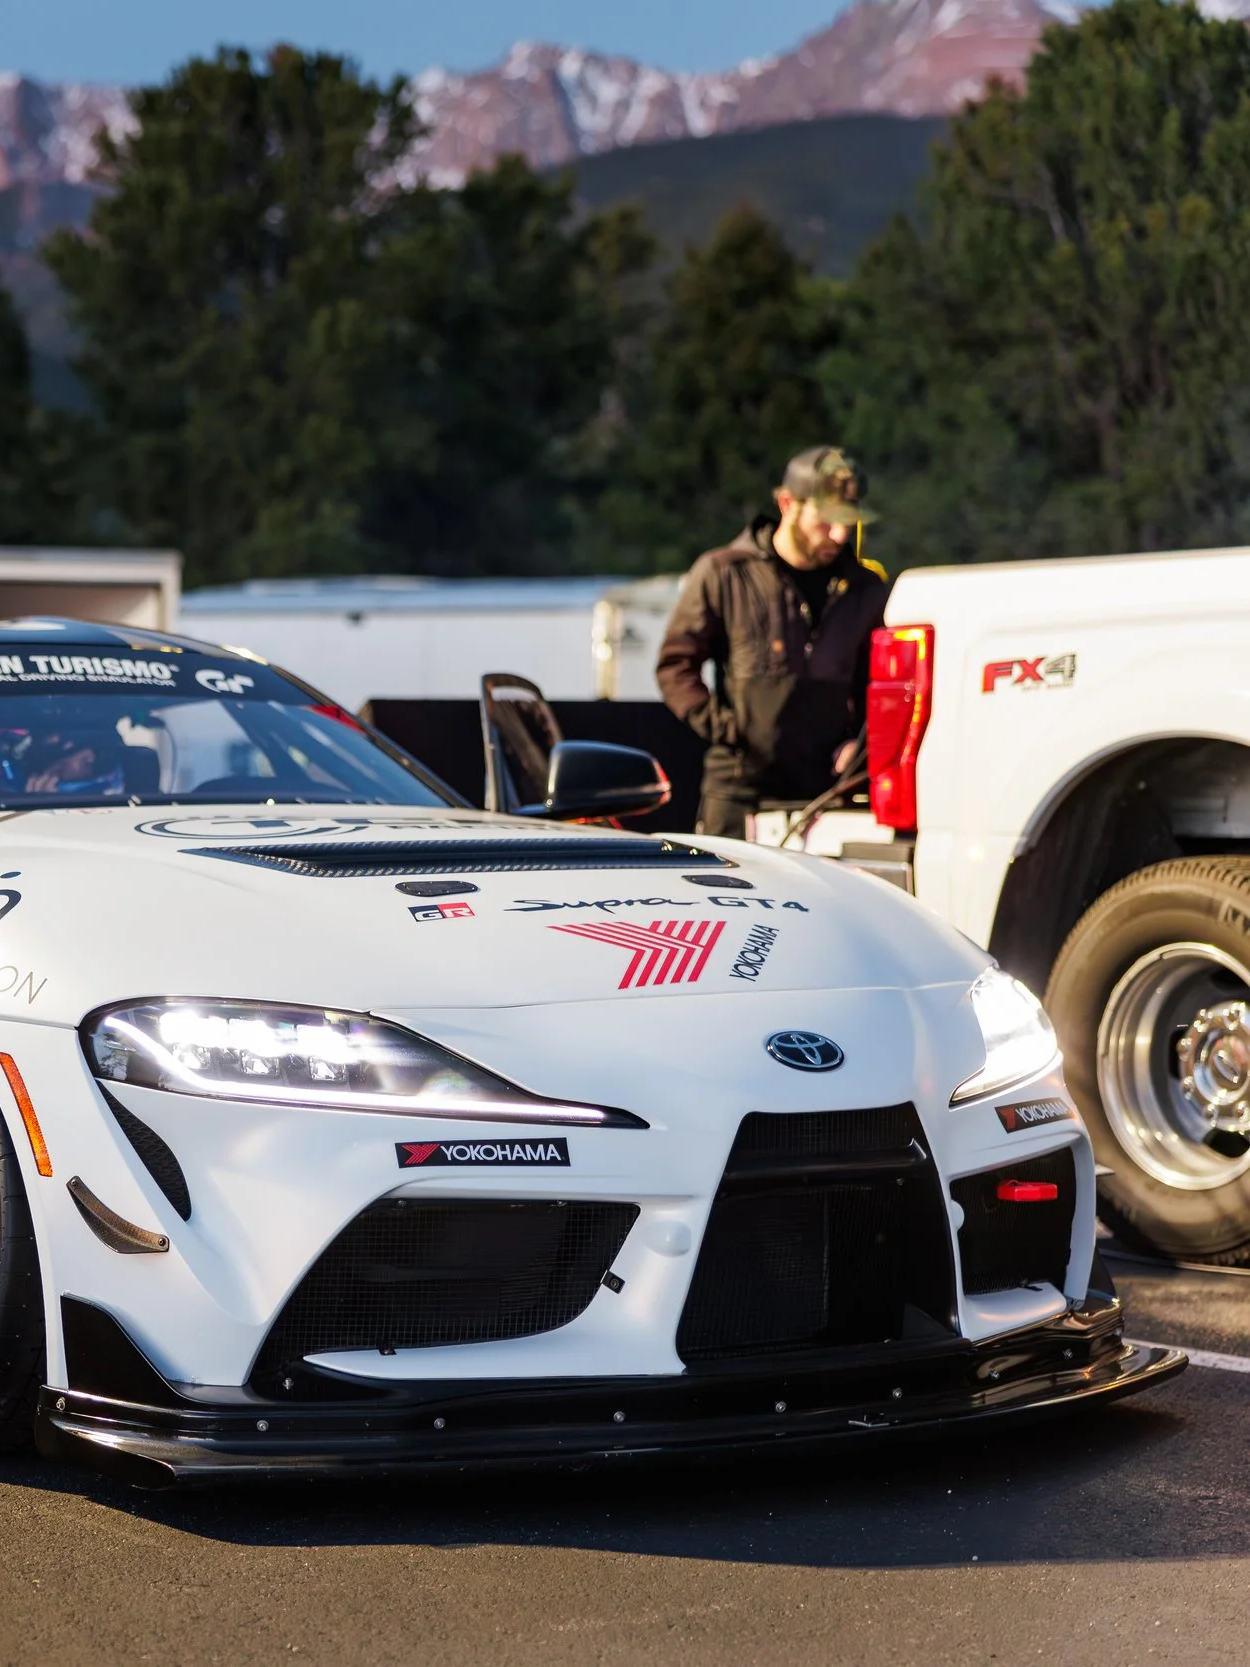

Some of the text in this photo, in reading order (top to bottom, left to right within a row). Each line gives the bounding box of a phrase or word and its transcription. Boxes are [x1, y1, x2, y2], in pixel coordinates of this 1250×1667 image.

[19, 673, 85, 682] DRIVING
[87, 674, 177, 687] SIMULATOR
[982, 654, 1076, 692] FX4
[411, 905, 474, 921] GR
[503, 896, 809, 914] Supra GT4
[729, 923, 780, 982] YOKOHAMA
[440, 1144, 562, 1161] YOKOHAMA
